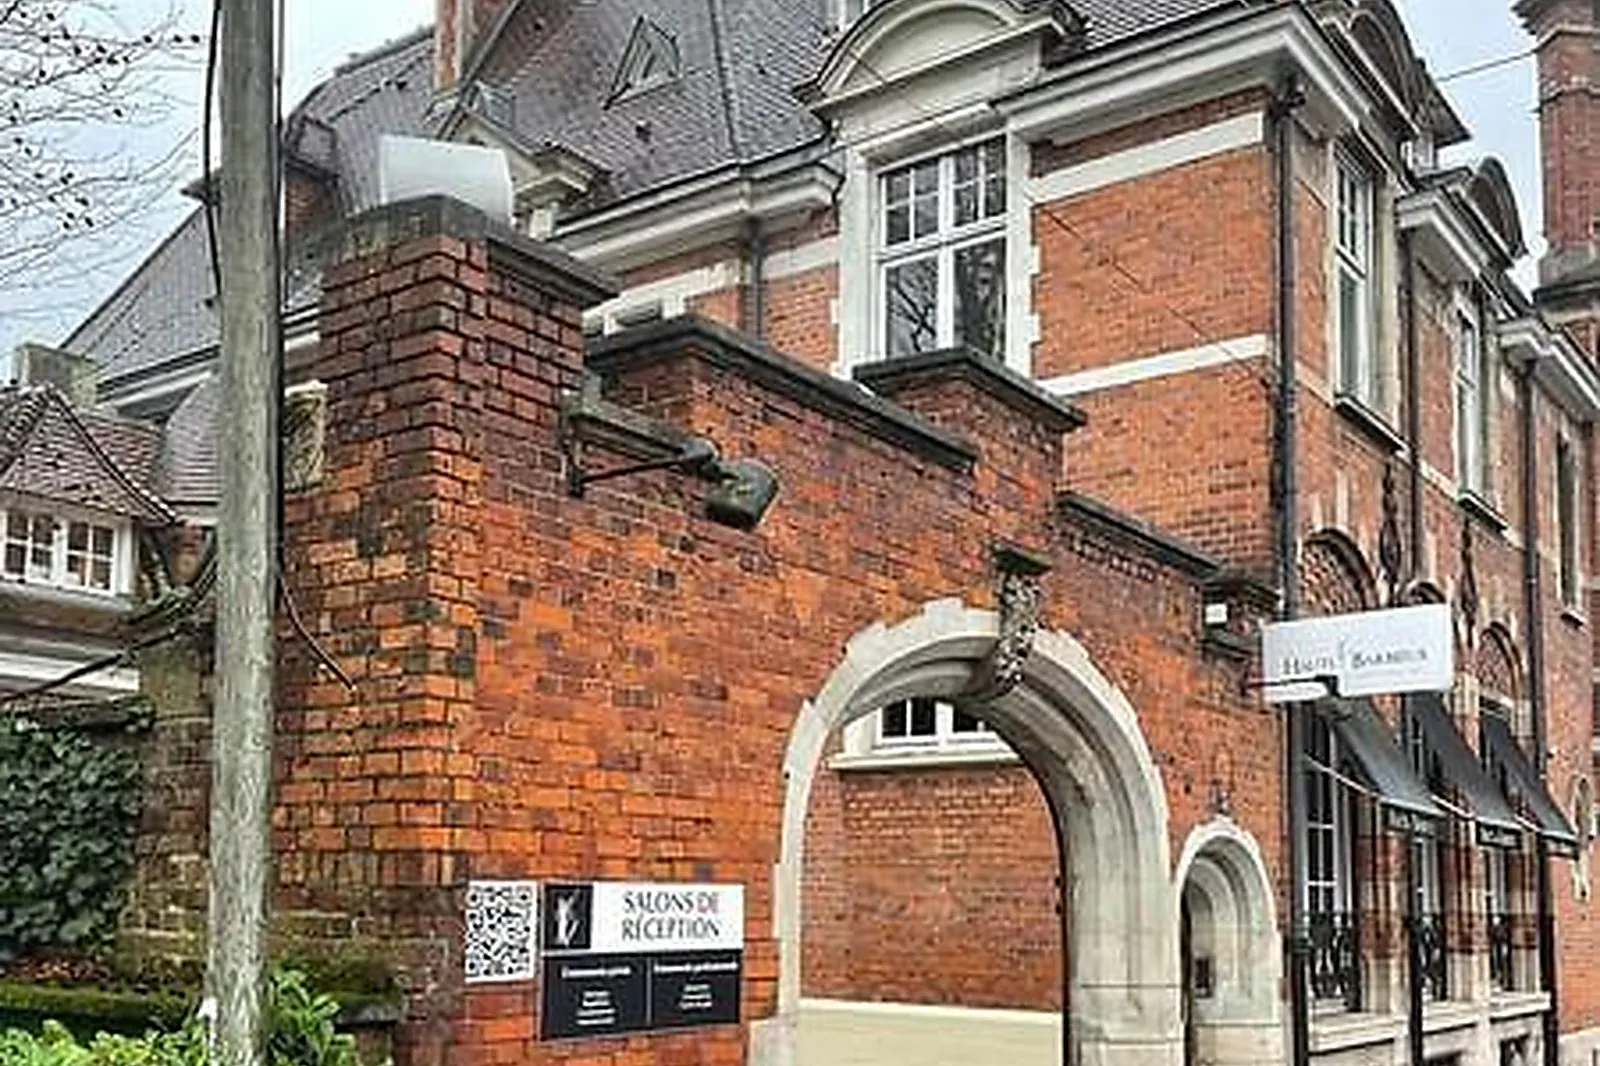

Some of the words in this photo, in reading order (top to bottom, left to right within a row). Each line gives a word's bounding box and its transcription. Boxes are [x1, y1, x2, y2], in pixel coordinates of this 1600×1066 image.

[622, 890, 693, 914] SALONS
[697, 890, 719, 914] DE
[621, 912, 722, 942] RÉCEPTION
